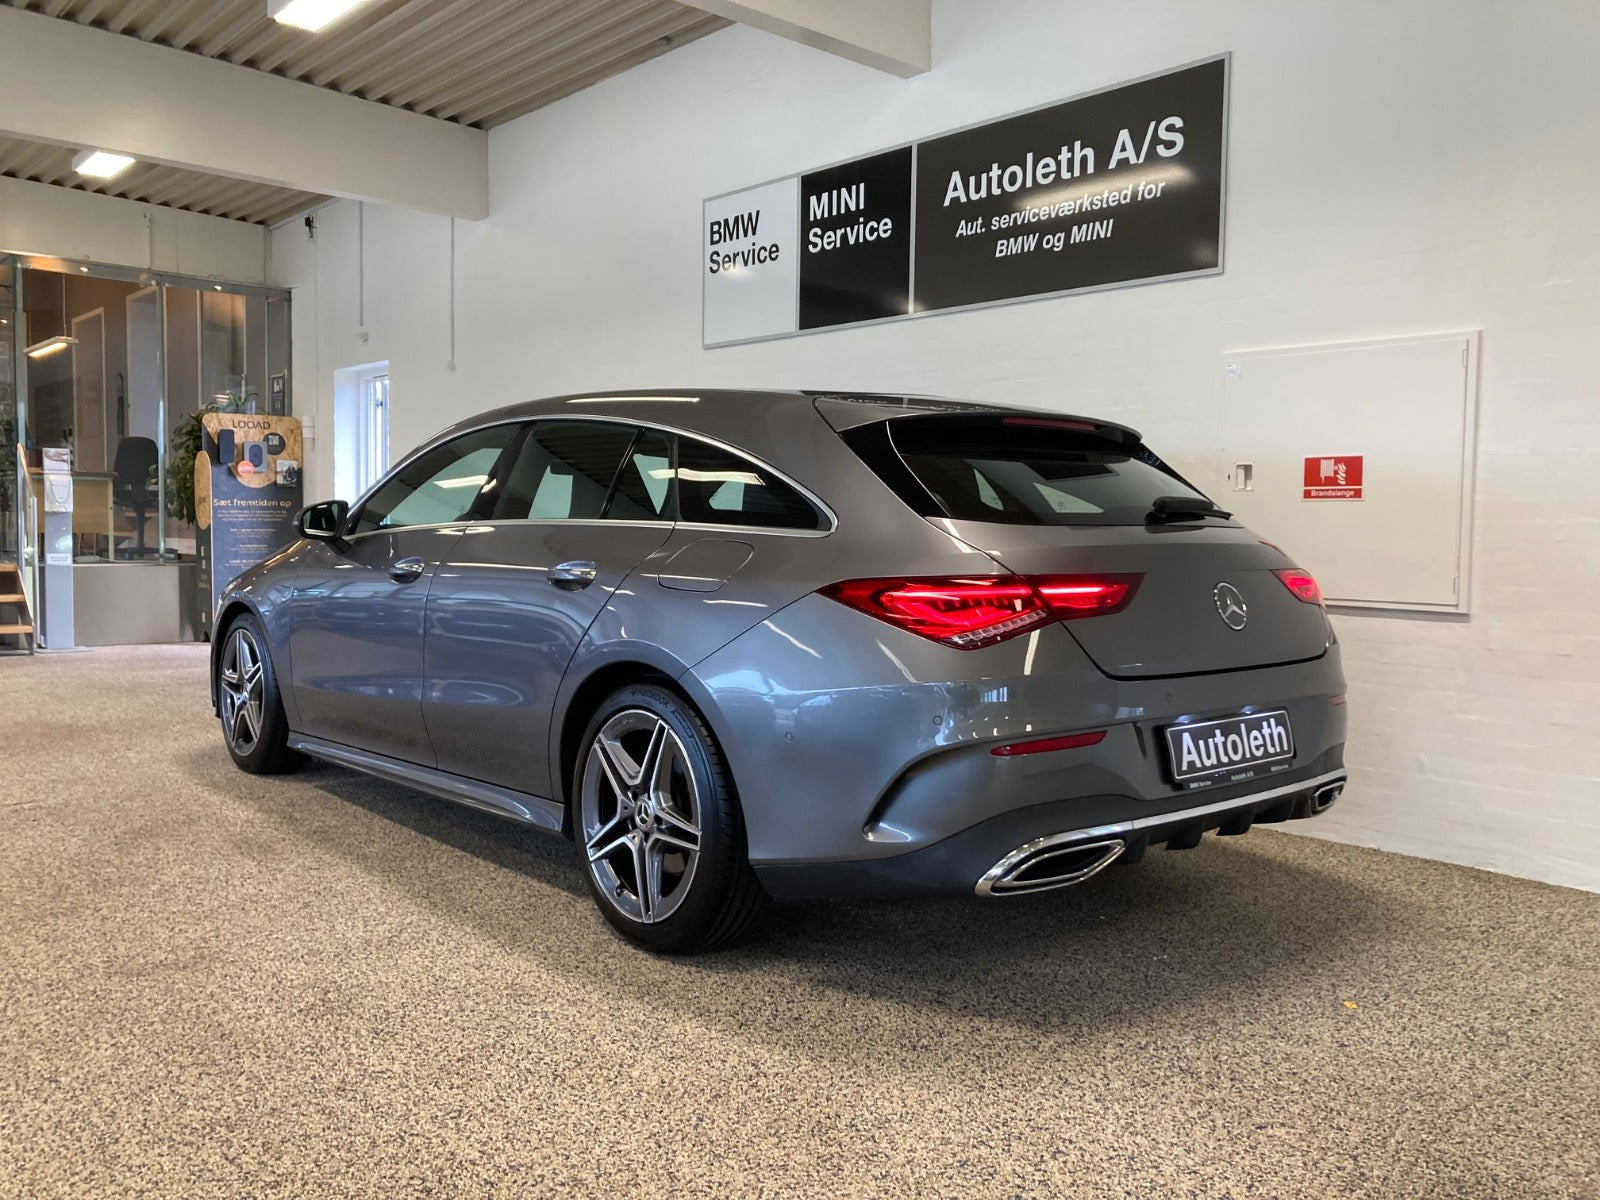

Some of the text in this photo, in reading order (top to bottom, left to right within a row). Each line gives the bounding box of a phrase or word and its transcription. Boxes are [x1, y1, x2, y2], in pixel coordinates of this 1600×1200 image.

[943, 116, 1185, 207] Autoleth A/S
[809, 182, 865, 222] MINI
[955, 180, 1166, 238] Aut. serviceværksted for
[709, 210, 760, 246] BMW
[808, 217, 893, 253] Service
[995, 219, 1115, 258] BMW og MINI
[709, 242, 780, 274] Service
[232, 420, 271, 430] LOOAD
[213, 498, 292, 508] Sæt fremtiden op
[1310, 489, 1355, 498] Brandslange
[1181, 718, 1288, 771] Autoleth
